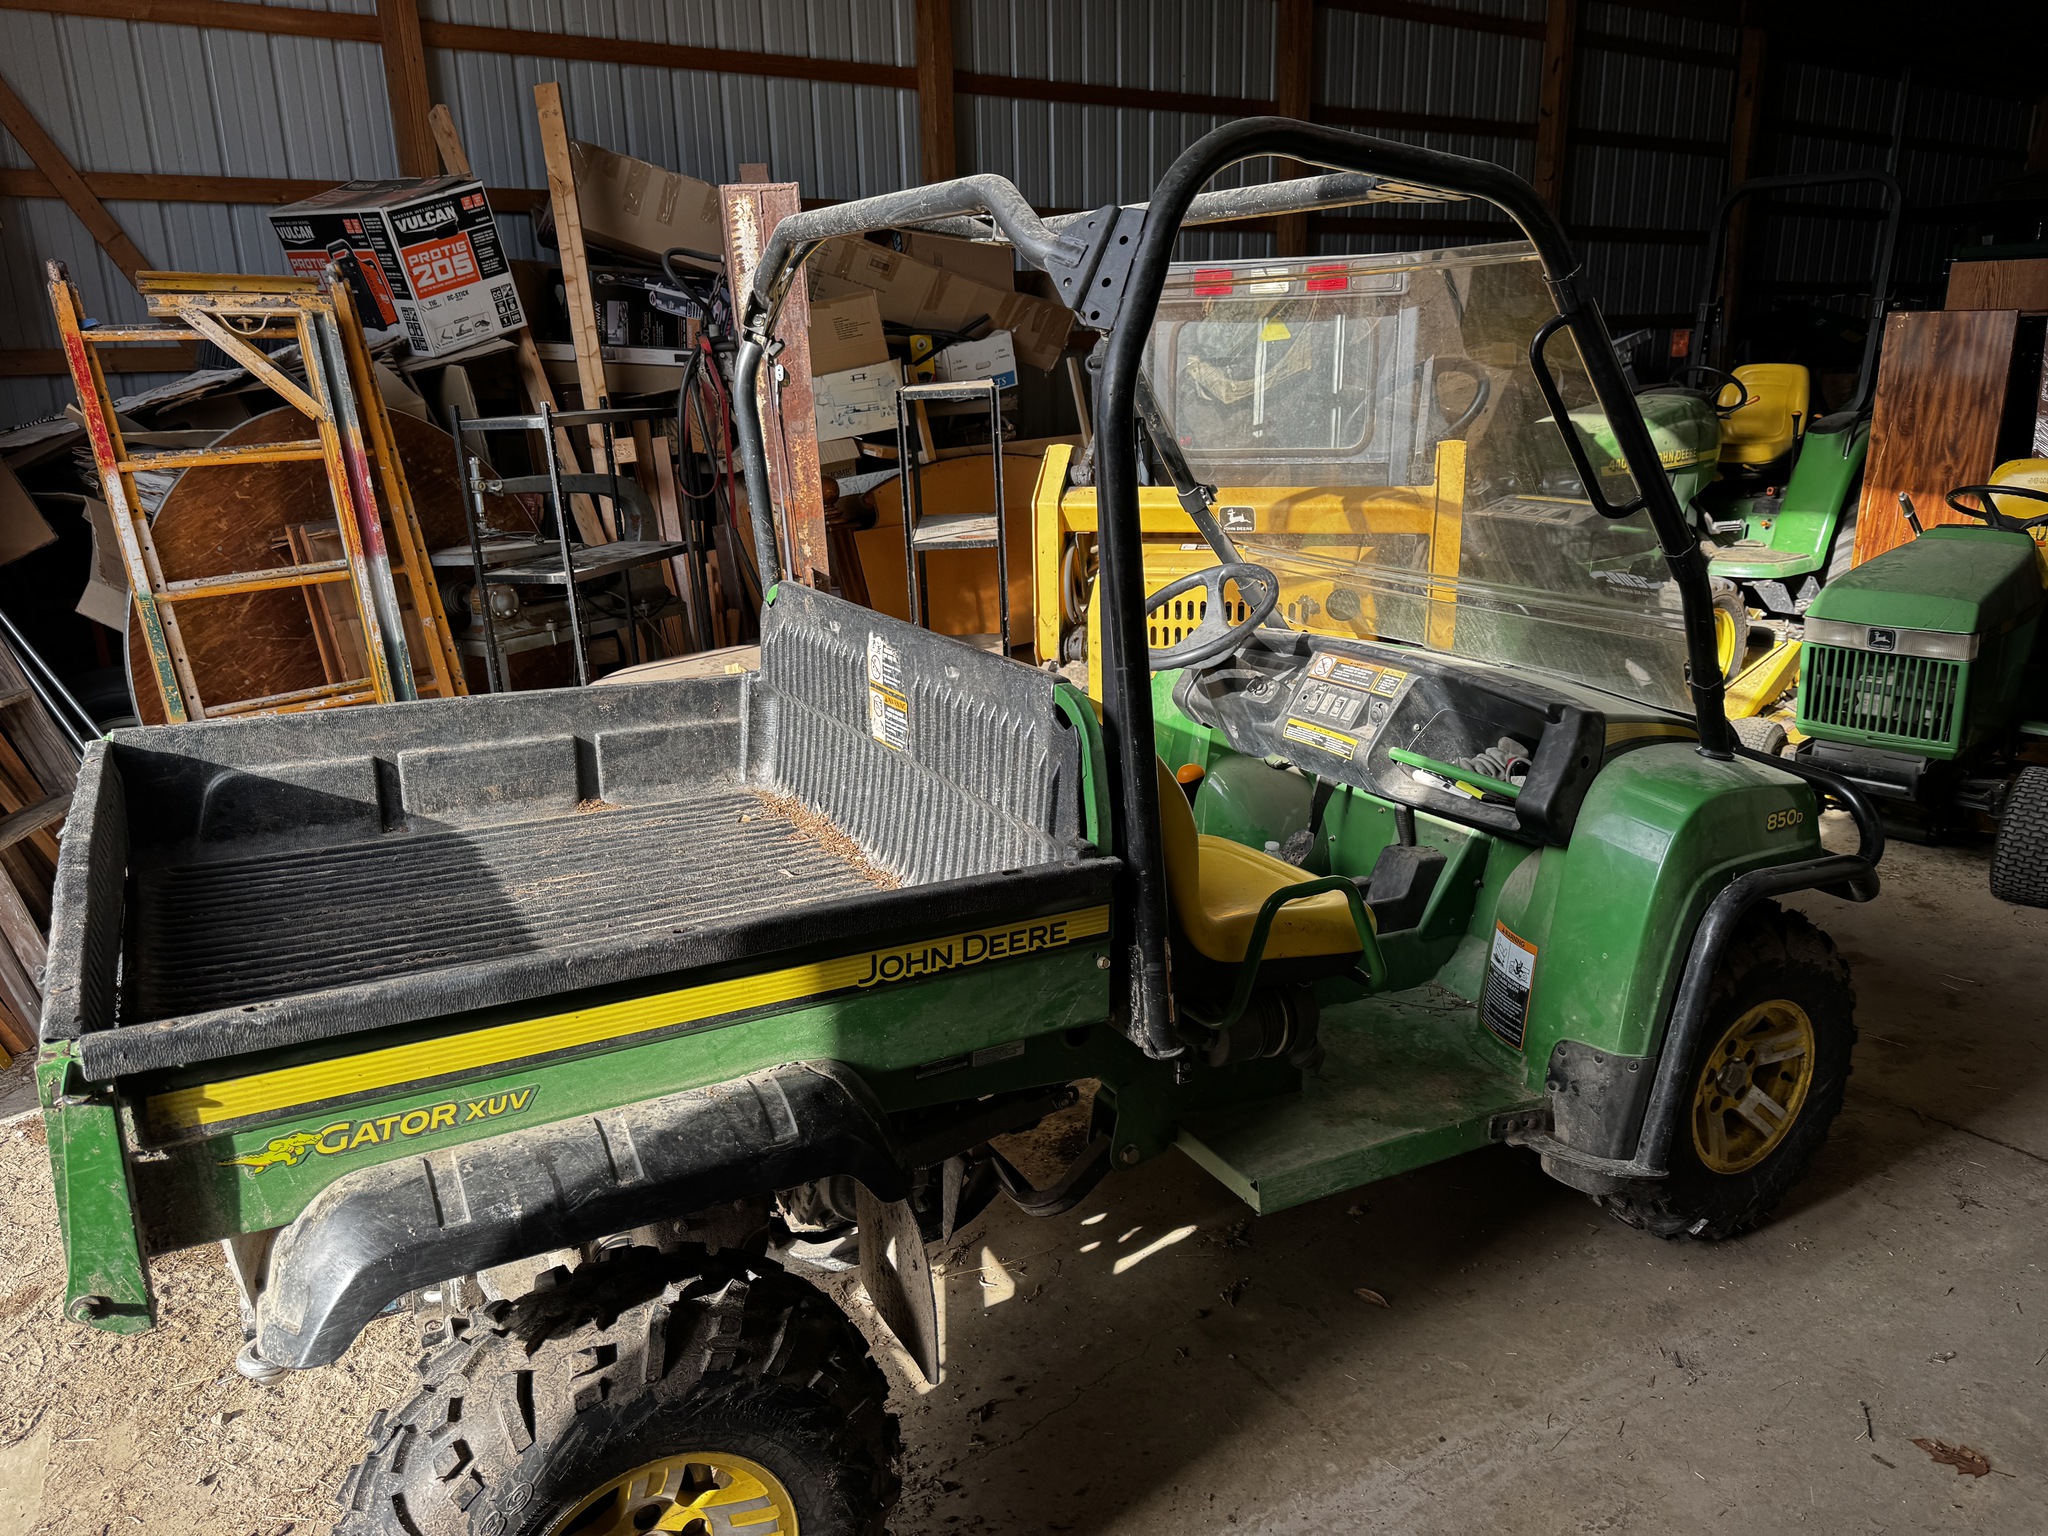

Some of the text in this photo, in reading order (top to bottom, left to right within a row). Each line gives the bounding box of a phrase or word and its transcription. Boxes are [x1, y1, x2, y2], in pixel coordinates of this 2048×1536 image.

[276, 225, 316, 240] VULCAN
[394, 206, 456, 233] VULCAN
[407, 240, 468, 267] PROTIG
[412, 252, 475, 289] 205
[446, 290, 470, 302] DC-STICK
[1658, 450, 1674, 464] OHN
[1675, 447, 1697, 462] DEERE
[857, 920, 1068, 986] JOHN DEERE
[314, 1088, 531, 1155] GATOR XUV
